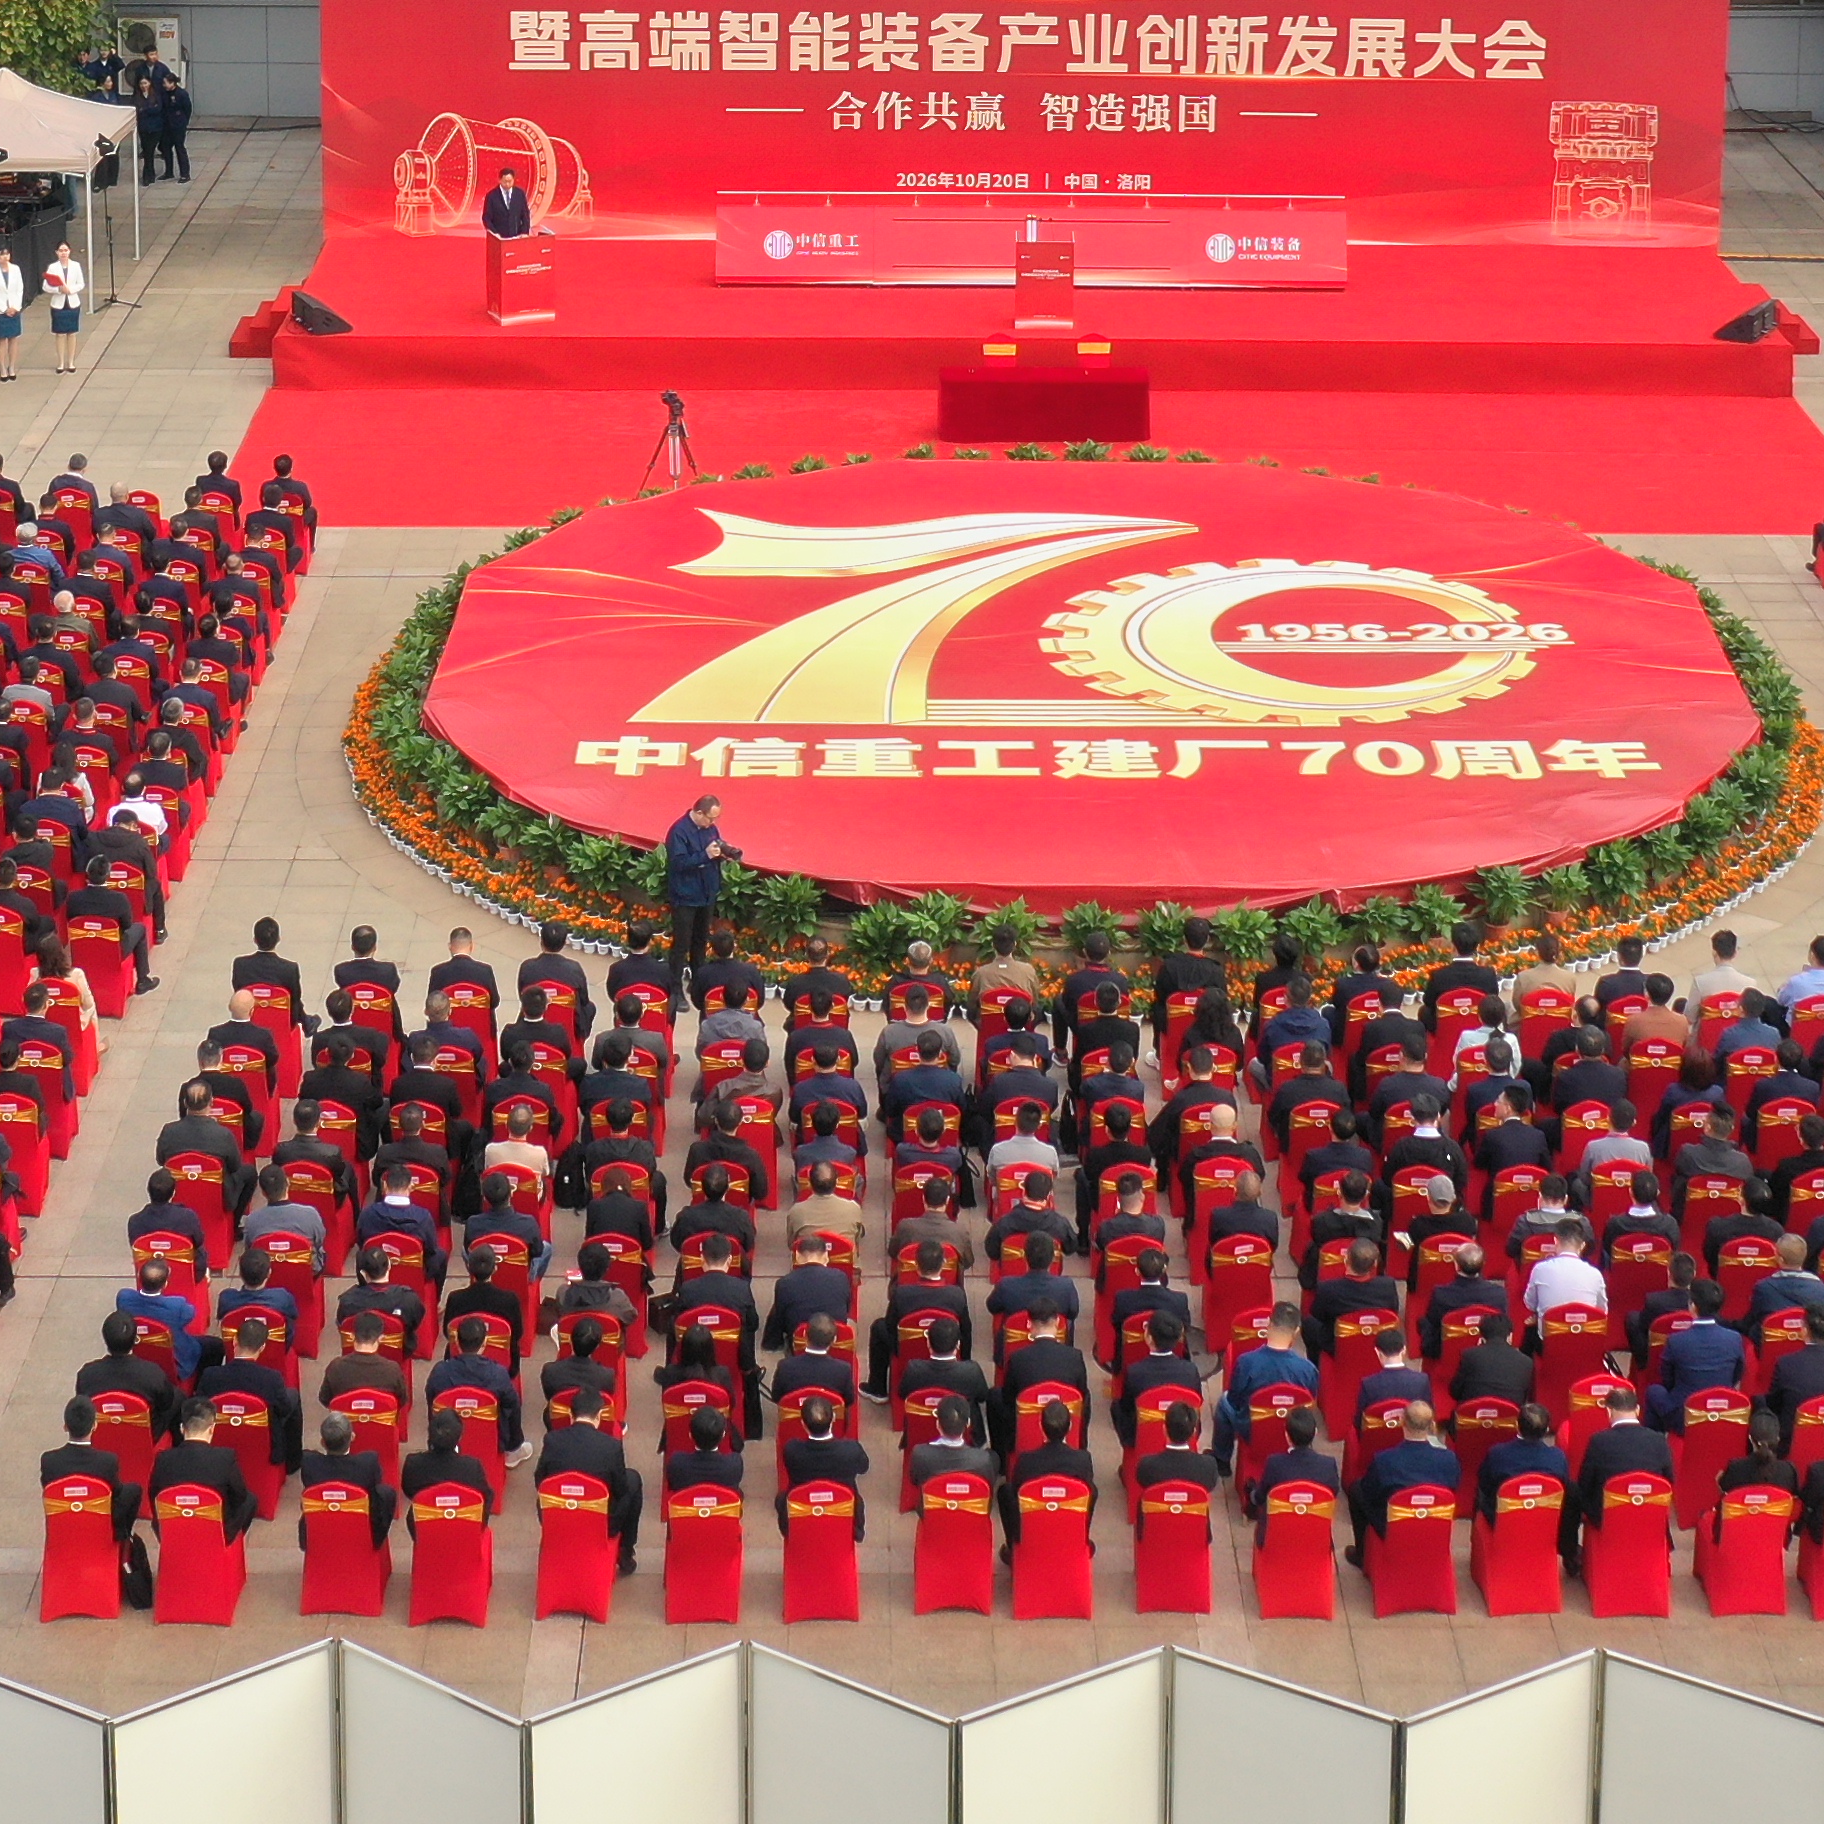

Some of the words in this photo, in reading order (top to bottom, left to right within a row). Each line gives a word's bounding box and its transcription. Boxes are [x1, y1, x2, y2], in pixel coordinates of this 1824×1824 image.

[508, 9, 1547, 79] 暨高端智能装备产业创新发展大会
[826, 90, 1006, 131] 合作共赢
[1039, 92, 1217, 133] 智造强国
[896, 172, 1029, 188] 2026年10月20日
[796, 232, 860, 248] 中信重工
[1238, 236, 1302, 252] 中信装备
[1236, 622, 1569, 642] 1956-2026
[573, 735, 1665, 781] 中信重工建厂70周年
